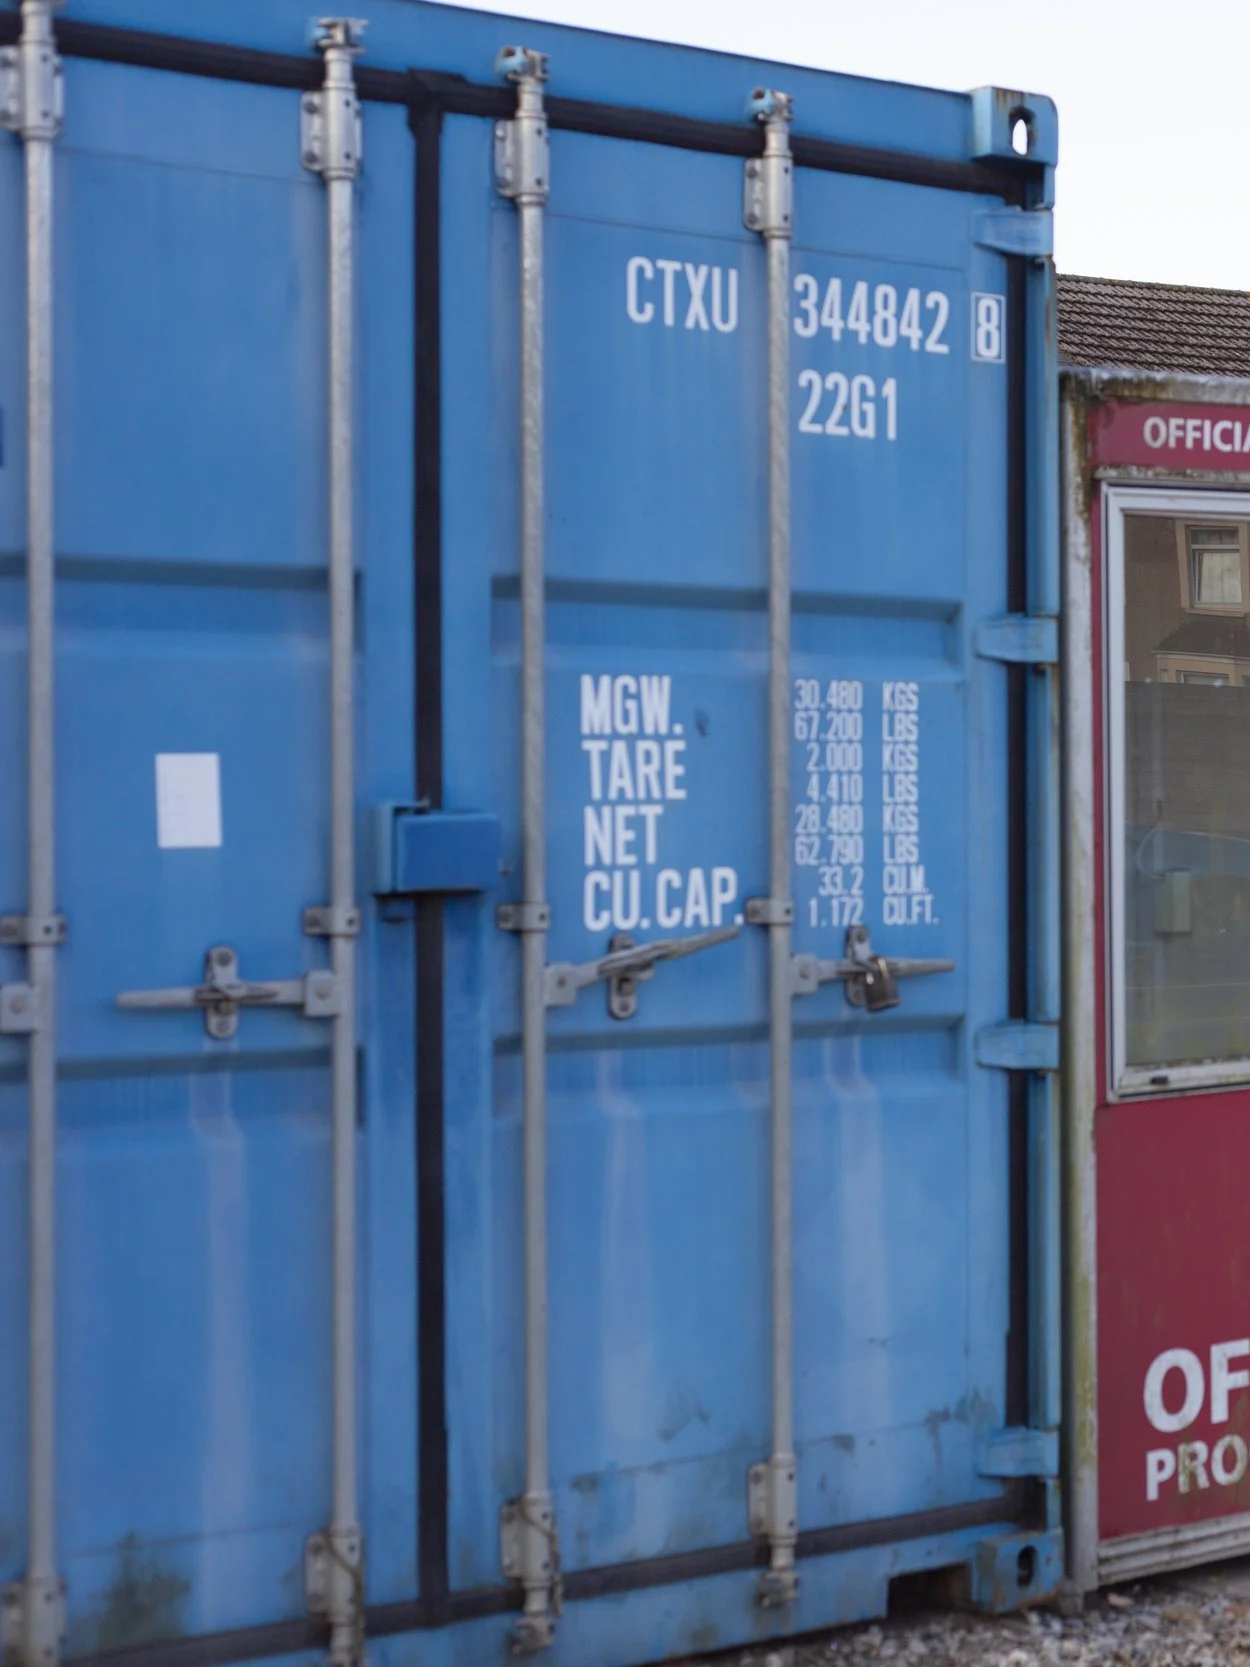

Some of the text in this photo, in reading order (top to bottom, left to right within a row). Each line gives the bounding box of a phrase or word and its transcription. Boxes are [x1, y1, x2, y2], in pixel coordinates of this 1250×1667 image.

[627, 256, 1003, 361] CTXU 344842 8
[798, 369, 897, 440] 22G1
[580, 674, 684, 735] MGW.
[794, 679, 919, 712] 30.480 KGS
[794, 711, 919, 742] 67.200 LBS
[581, 739, 687, 800] TARE
[806, 741, 919, 773] 2.000 KGS
[806, 772, 919, 803] 4.410 LBS
[583, 804, 664, 866] NET
[794, 803, 919, 835] 28.480 KGS
[794, 834, 919, 866] 62.790 LBS
[818, 865, 864, 897] 33.2
